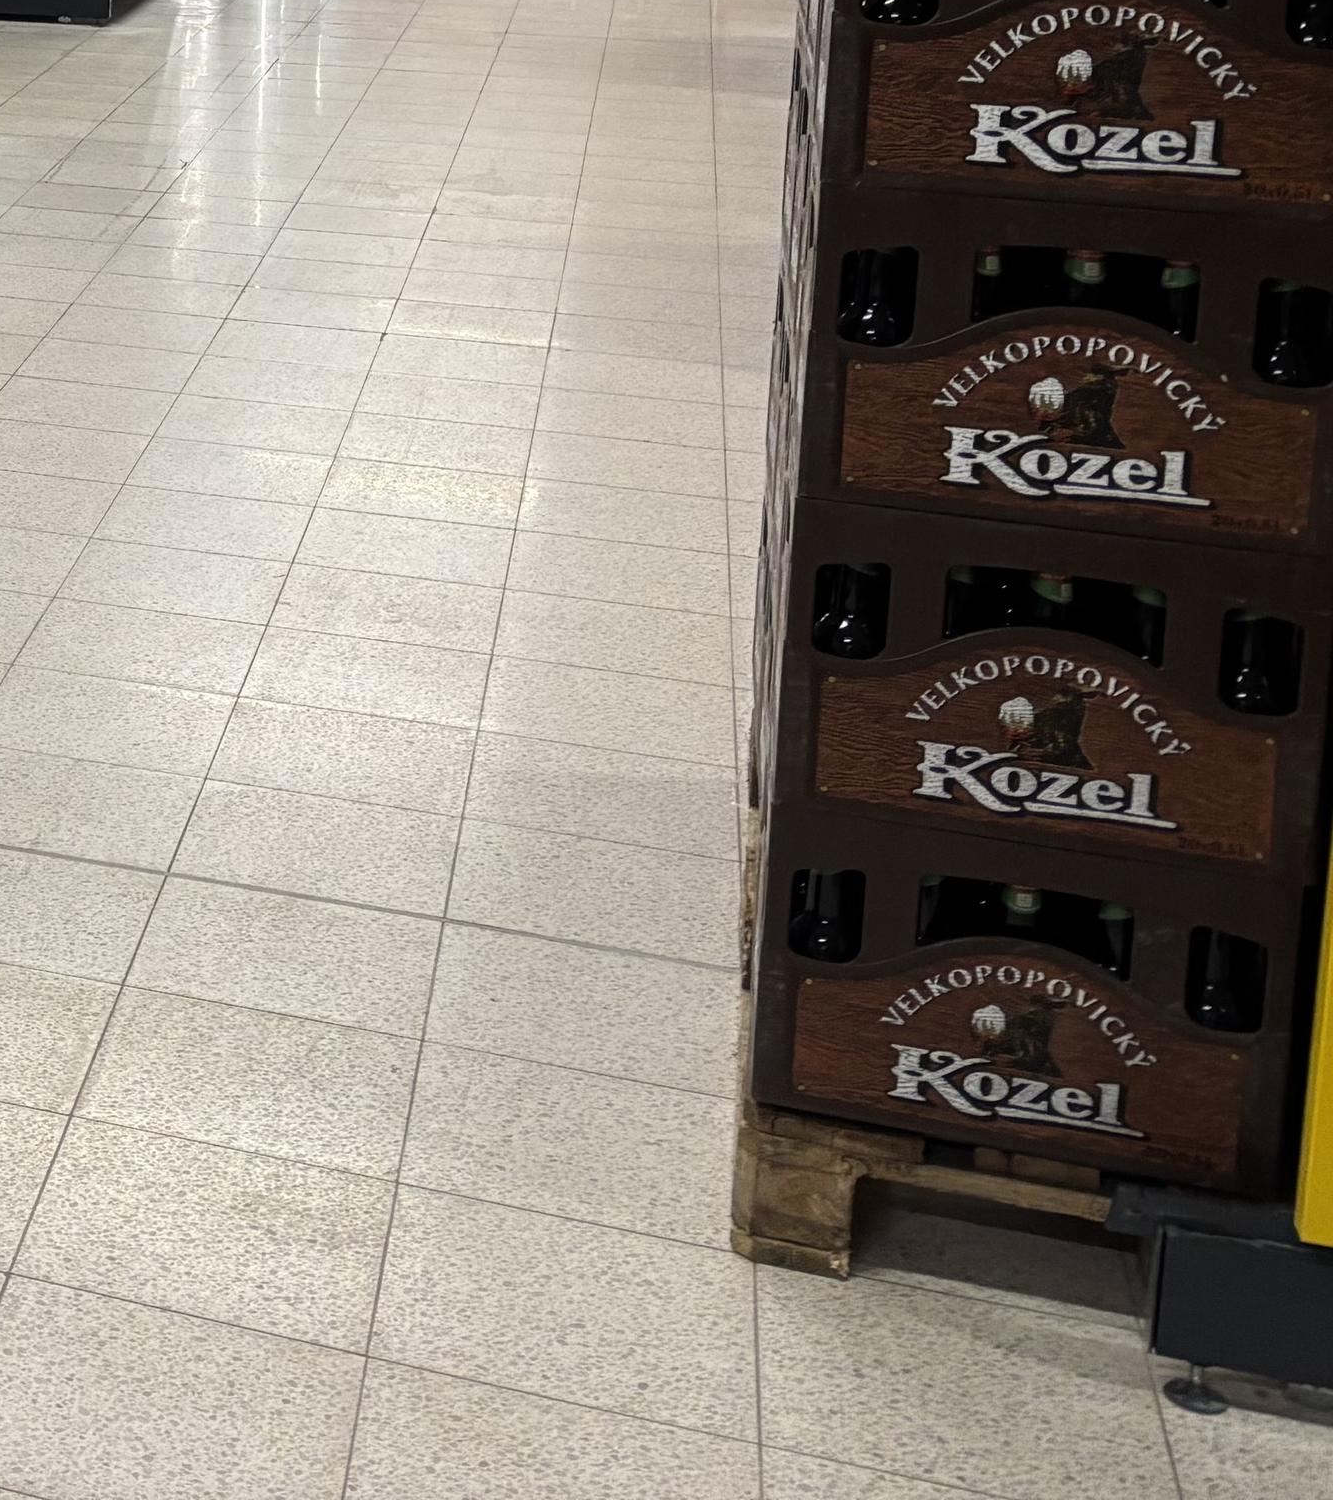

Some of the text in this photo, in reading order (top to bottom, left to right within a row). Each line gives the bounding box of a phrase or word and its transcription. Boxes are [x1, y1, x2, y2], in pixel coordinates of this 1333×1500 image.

[958, 5, 1259, 102] VELKOPOPOVICKÝ
[966, 103, 1228, 174] Kozel
[933, 334, 1227, 434] VELKOPOPOVICKÝ
[940, 426, 1198, 499] Kozel
[905, 655, 1193, 759] VELKOPOPOVICKÝ
[914, 740, 1162, 818] Kozel
[880, 964, 1158, 1070] VELKOPOPOVICKÝ
[888, 1043, 1129, 1122] Kozel
